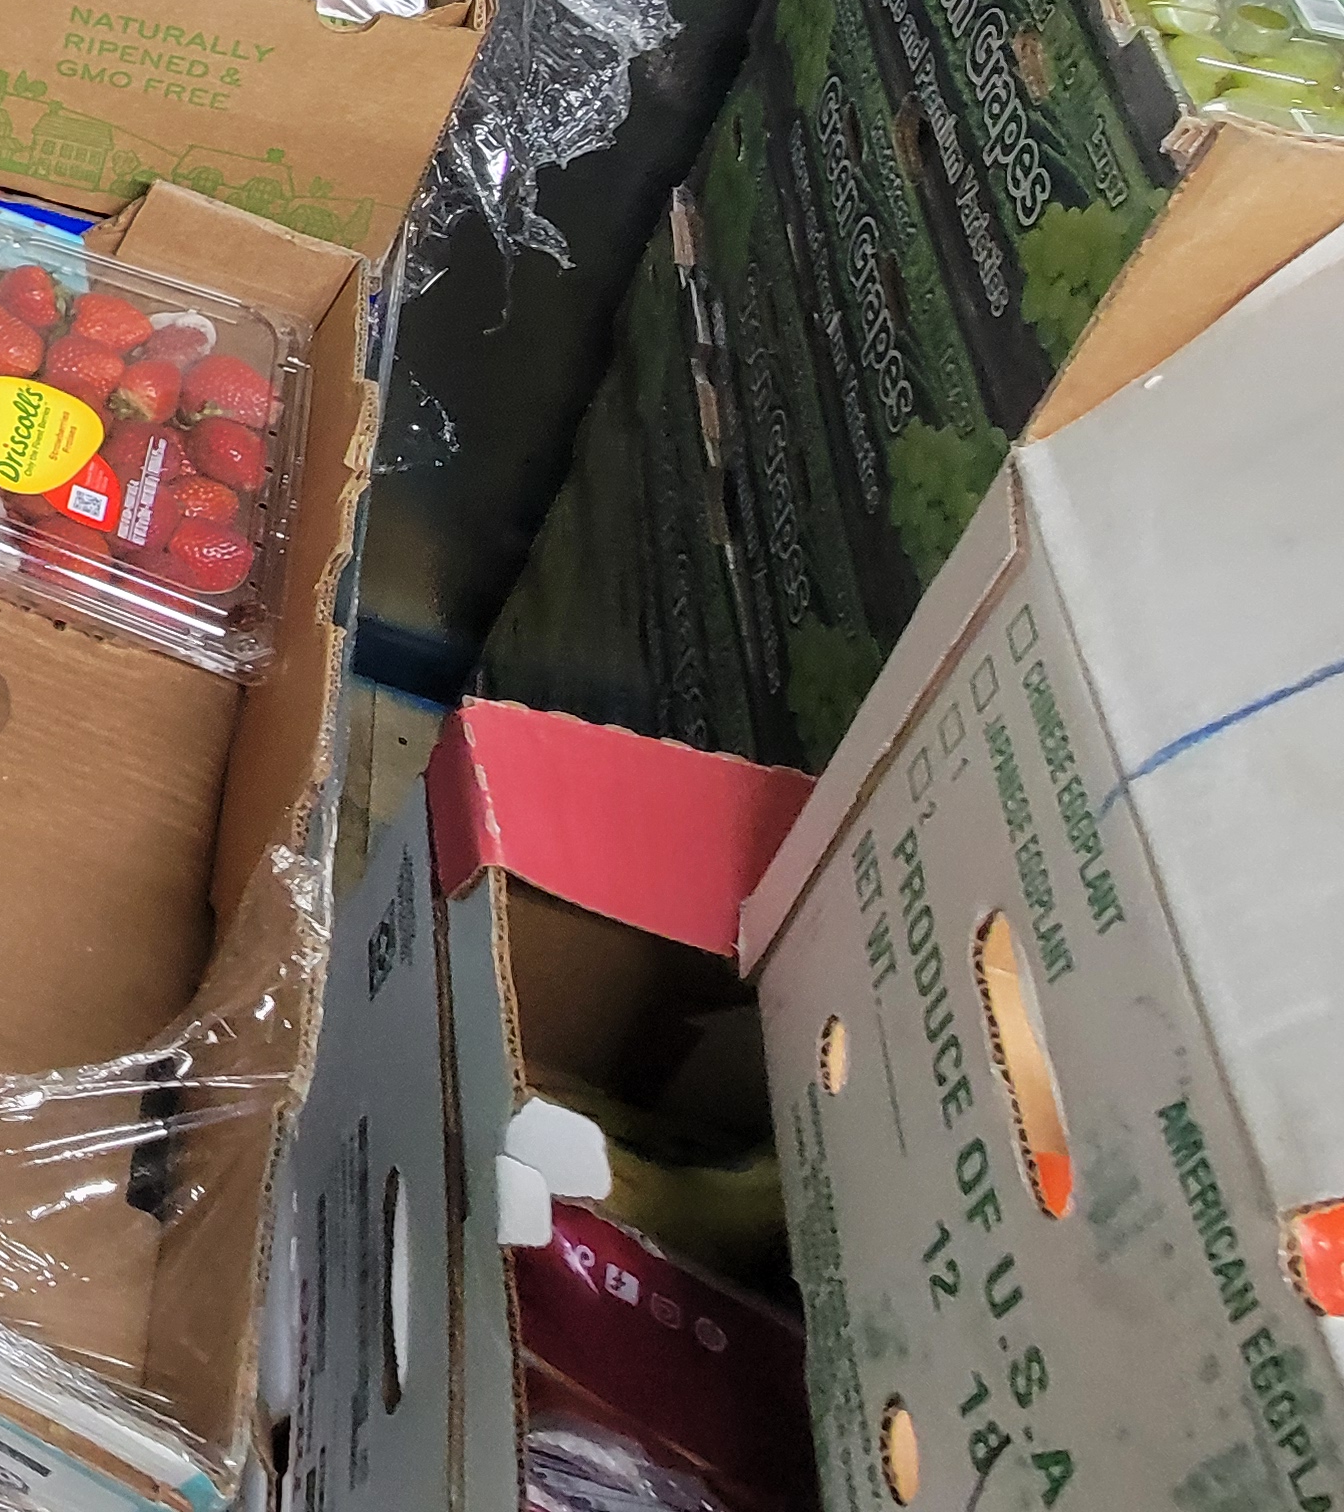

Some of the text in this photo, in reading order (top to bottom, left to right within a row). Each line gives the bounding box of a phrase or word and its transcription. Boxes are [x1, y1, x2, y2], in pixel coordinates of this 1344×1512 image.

[56, 59, 231, 112] GMO FREE
[64, 32, 242, 87] RIPENED &
[70, 5, 275, 63] NATURALLY
[898, 13, 931, 74] and
[914, 51, 965, 187] Premium
[965, 7, 1051, 228] Grapes
[818, 74, 853, 237] Green
[847, 216, 912, 434] Grapes
[983, 713, 1075, 984] JAPANESE EGGPLANT
[1022, 659, 1125, 935] CHINESE EGGPLANT
[851, 829, 884, 914] NET
[891, 826, 974, 1130] PRODUCE
[954, 1136, 1003, 1234] OF
[923, 1219, 962, 1314] 12
[1156, 1099, 1261, 1325] AMERICAN
[959, 1369, 1014, 1478] 18
